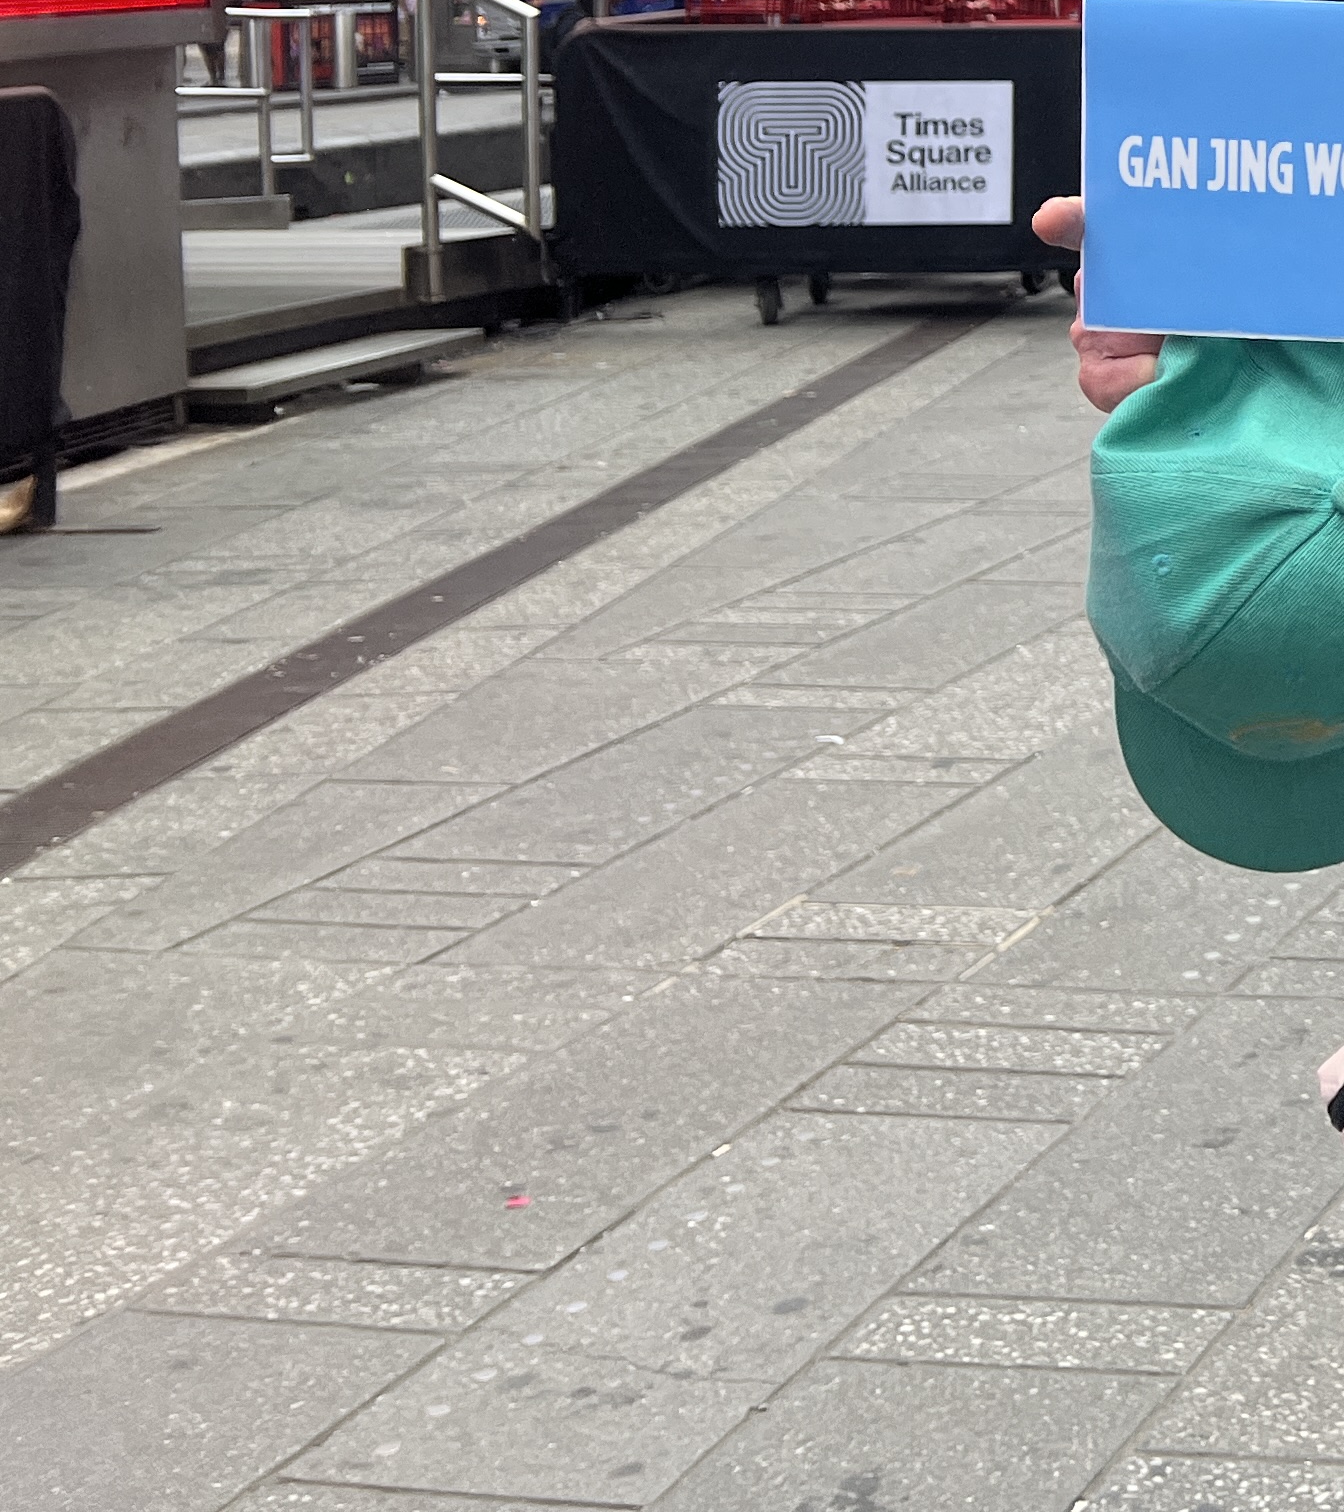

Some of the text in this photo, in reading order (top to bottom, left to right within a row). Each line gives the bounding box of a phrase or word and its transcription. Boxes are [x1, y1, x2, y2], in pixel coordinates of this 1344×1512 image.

[894, 111, 985, 137] Times
[885, 139, 992, 168] Square
[1117, 135, 1198, 190] GAN
[1206, 139, 1294, 195] JING
[890, 172, 987, 193] Alliance
